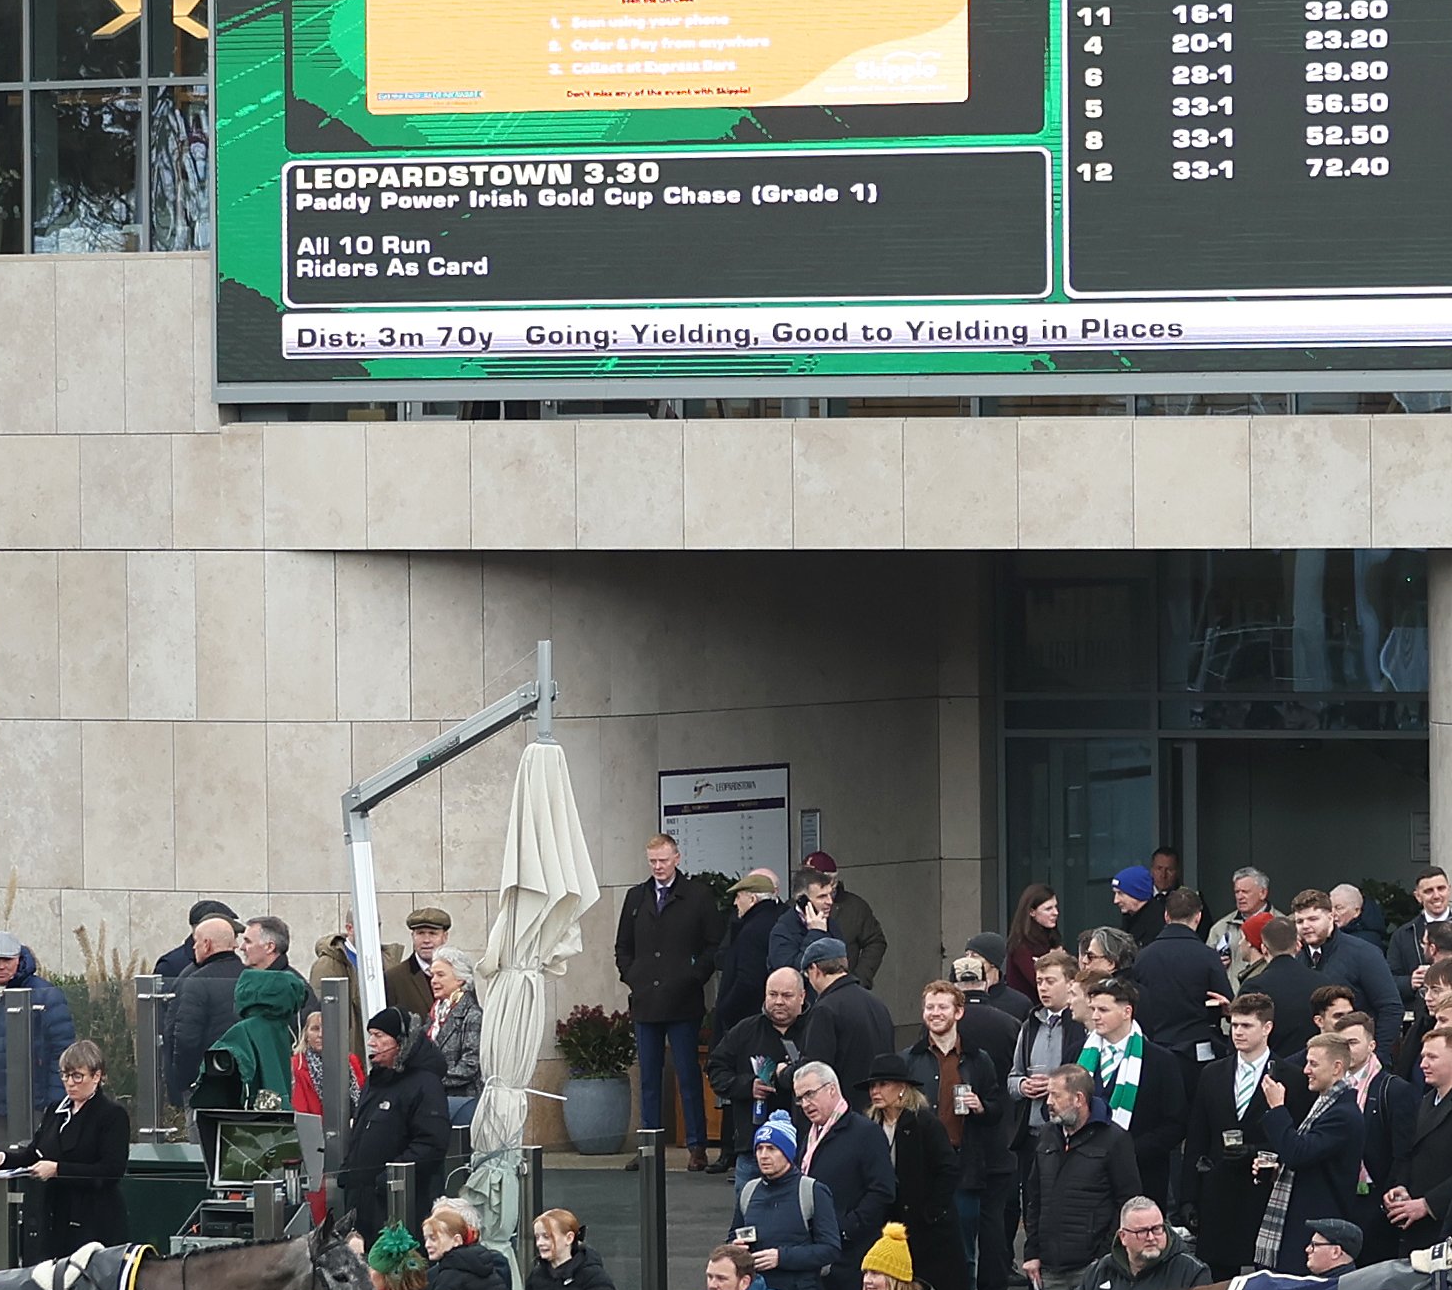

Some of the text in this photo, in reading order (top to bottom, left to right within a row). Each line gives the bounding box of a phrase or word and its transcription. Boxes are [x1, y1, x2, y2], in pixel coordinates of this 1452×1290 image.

[608, 15, 645, 31] using
[648, 16, 682, 31] your
[684, 13, 730, 29] phone
[1076, 6, 1111, 27] 11
[1173, 3, 1233, 24] 16-1
[1305, 0, 1389, 21] 32.60
[571, 39, 614, 52] Order
[630, 37, 658, 53] Pay
[661, 36, 696, 50] from
[698, 34, 771, 52] anywhere
[1084, 35, 1103, 55] 4
[1172, 32, 1232, 53] 20-1
[1306, 28, 1388, 50] 23.20
[571, 61, 624, 75] Collect
[626, 61, 642, 74] at
[644, 61, 701, 76] Express
[854, 59, 939, 85] Skippio
[1085, 67, 1103, 87] 6
[1173, 64, 1233, 85] 28-1
[1306, 60, 1389, 82] 29.80
[634, 88, 645, 97] of
[647, 88, 663, 97] the
[664, 88, 693, 97] event
[694, 87, 714, 96] with
[1085, 99, 1103, 118] 5
[1173, 96, 1233, 117] 33-1
[1306, 92, 1389, 114] 56.50
[1086, 130, 1103, 150] 8
[1173, 127, 1233, 149] 33-1
[1307, 124, 1389, 146] 52.50
[295, 162, 660, 191] LEOPARDSTOWN 3.30
[1076, 162, 1113, 182] 12
[1173, 160, 1234, 180] 33-1
[1306, 156, 1390, 177] 72.40
[296, 182, 878, 213] Paddy Power Irish Gold Cup Chase (Grade 1)
[296, 235, 431, 256] All 10 Run
[296, 256, 488, 278] Riders As Card
[298, 317, 1185, 352] Dist: 3m 70y Going: Yielding, Good to Yielding in Places
